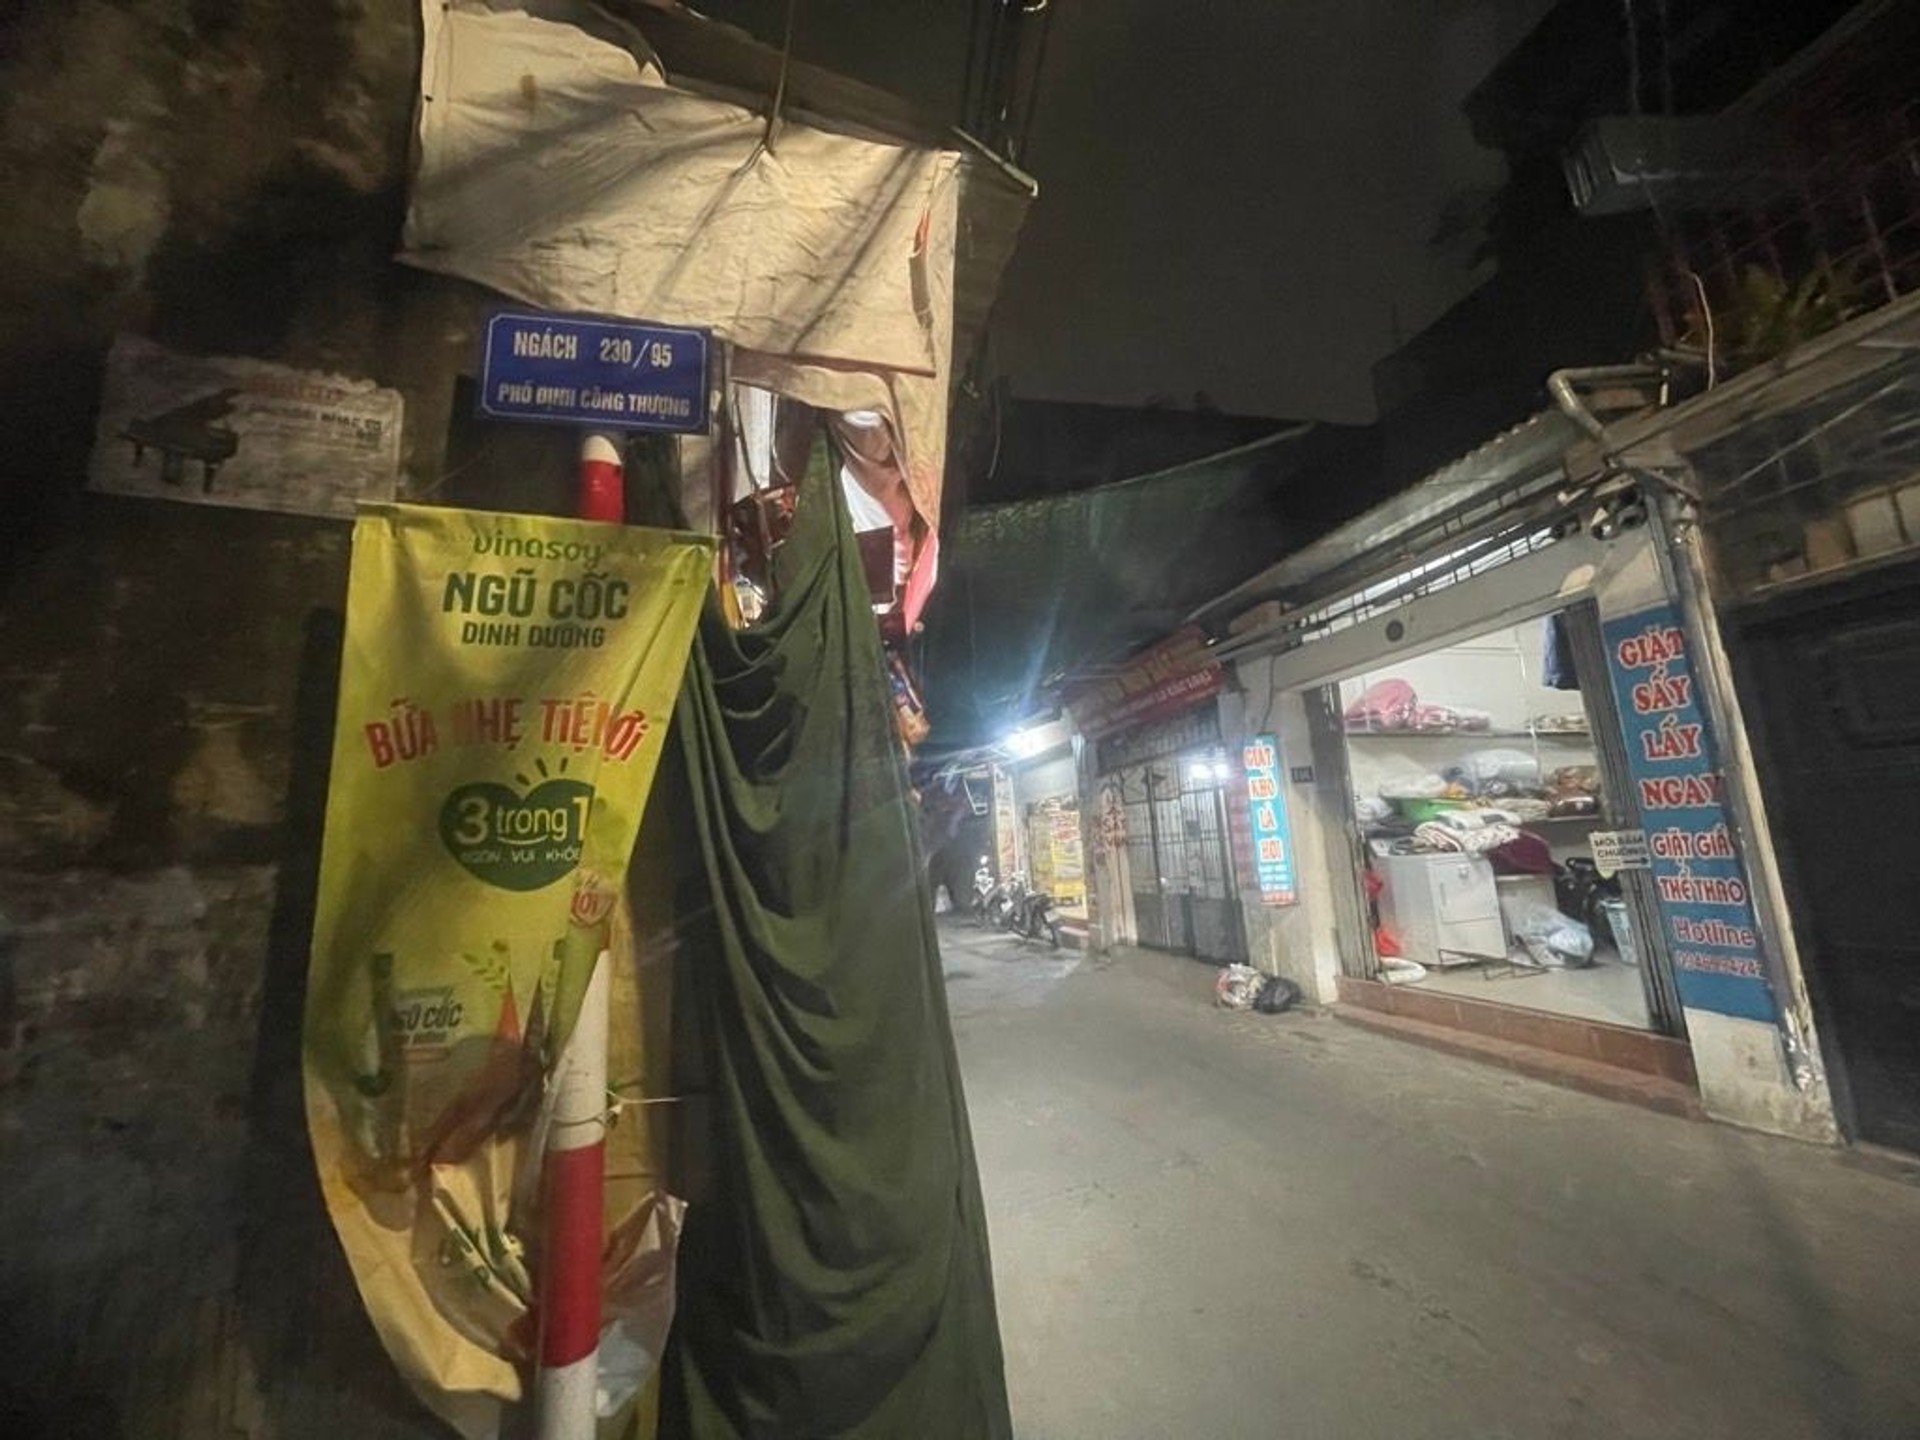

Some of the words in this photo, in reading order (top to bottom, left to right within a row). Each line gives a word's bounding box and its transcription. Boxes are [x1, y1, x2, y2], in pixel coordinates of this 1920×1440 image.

[513, 327, 577, 360] NGÁCH
[600, 338, 672, 369] 230/95
[499, 380, 532, 404] PHỐ
[580, 386, 624, 412] CÔNG
[628, 393, 690, 420] THƯỢNG
[443, 568, 538, 617] NGŨ
[547, 571, 630, 620] CỐC
[462, 621, 520, 647] DINH
[1634, 664, 1690, 713] SẤY
[1642, 713, 1702, 760] LẤY
[1640, 773, 1724, 809] NGAY
[455, 797, 490, 844] 3
[496, 806, 568, 842] trong
[572, 796, 589, 841] 1
[1692, 876, 1746, 905] THAO
[1672, 916, 1756, 948] Hotline
